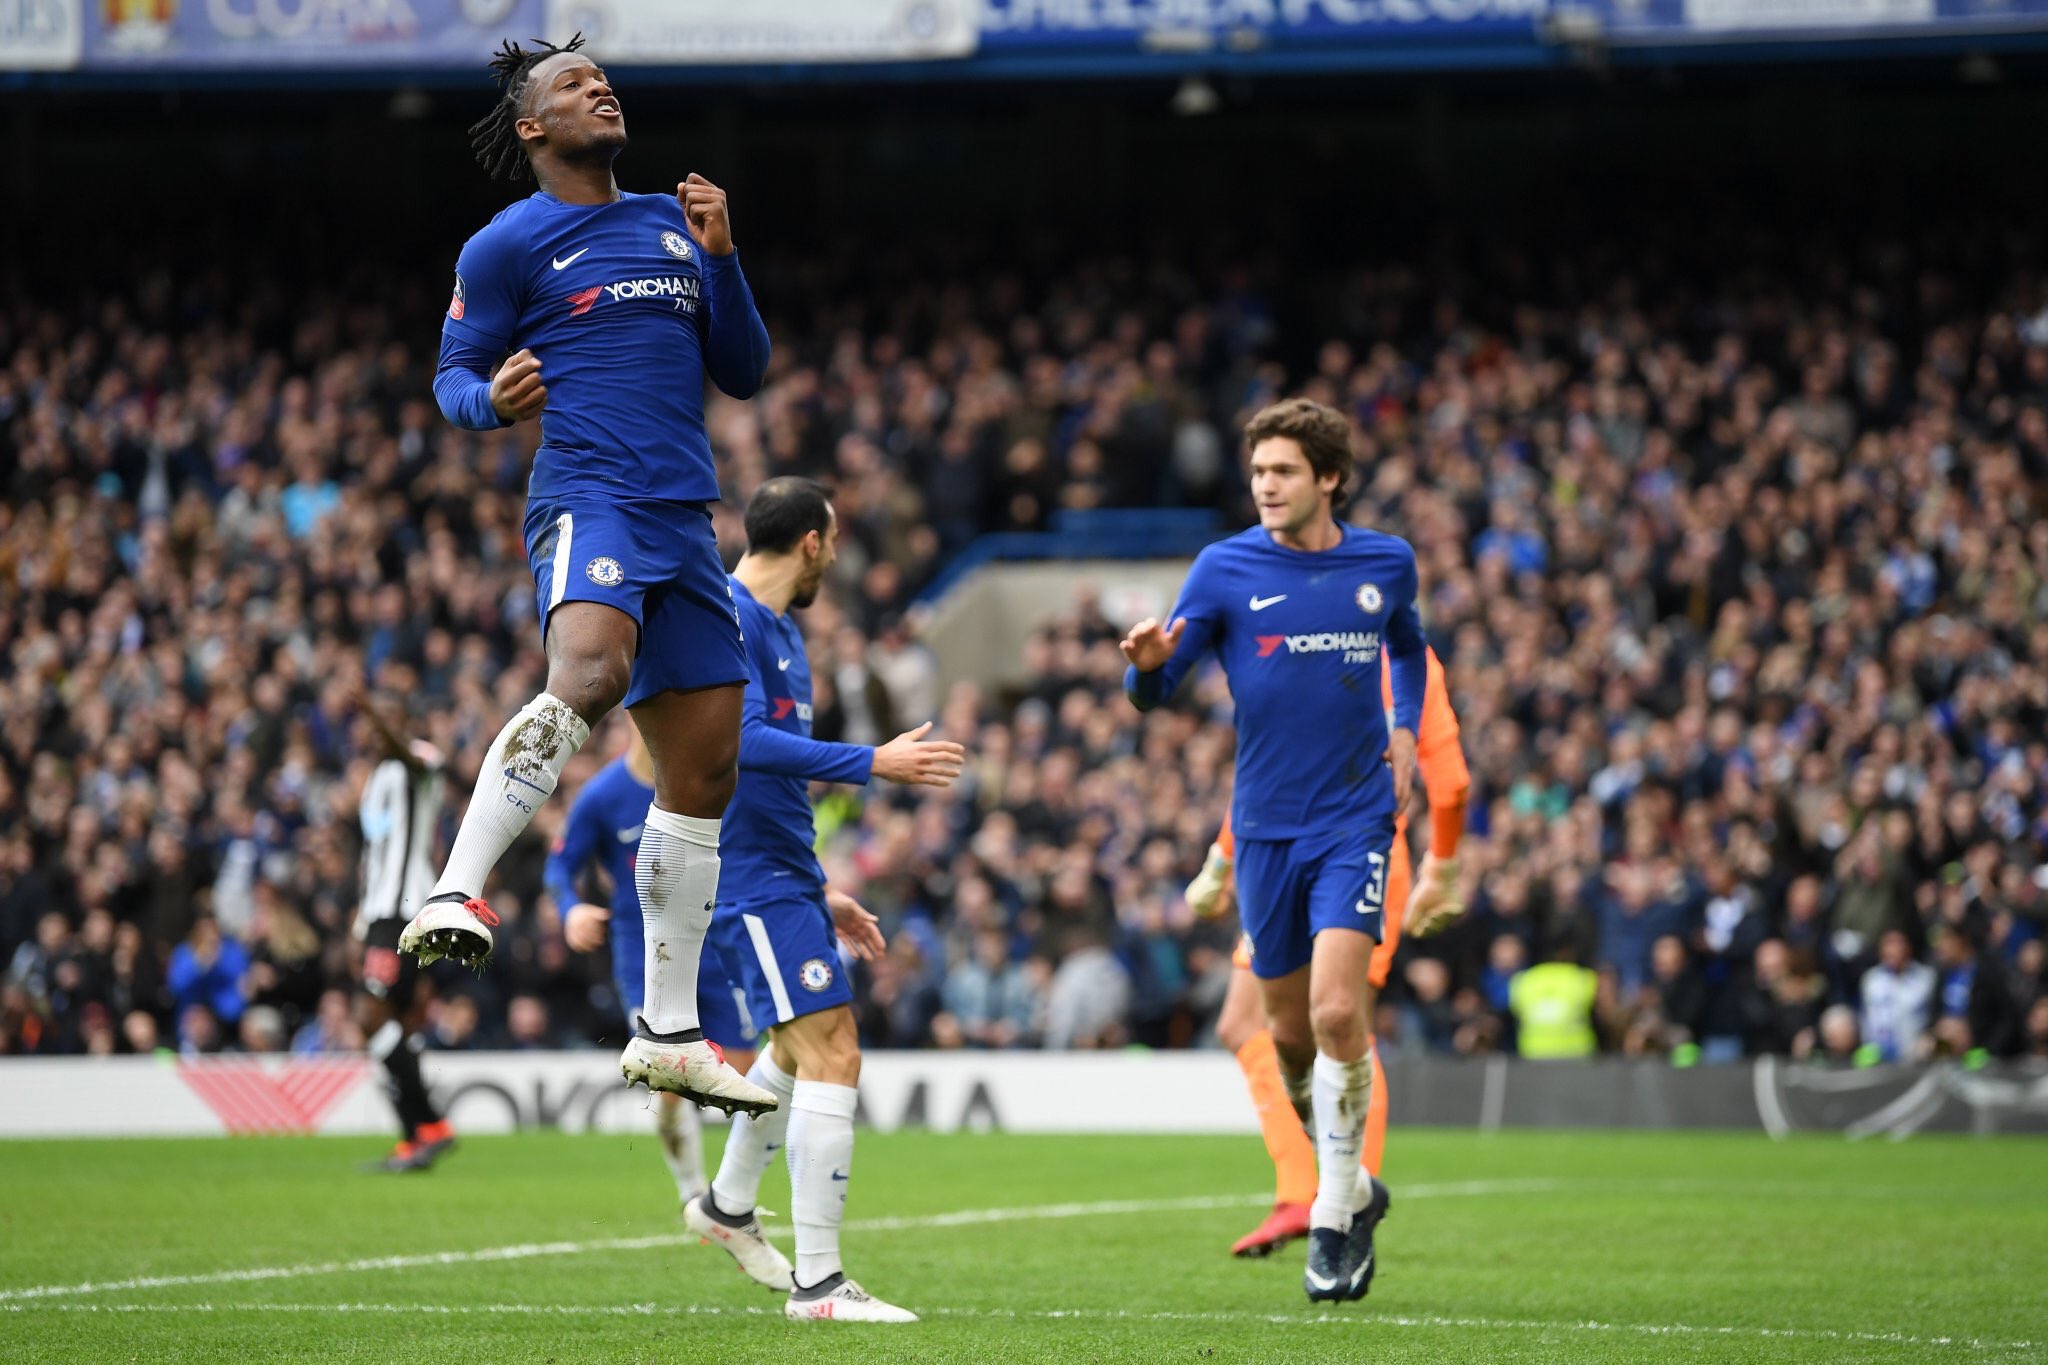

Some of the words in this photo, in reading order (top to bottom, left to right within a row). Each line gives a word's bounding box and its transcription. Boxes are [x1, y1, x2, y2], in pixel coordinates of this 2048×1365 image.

[674, 297, 698, 313] TYRE
[506, 793, 532, 814] CFC
[1365, 852, 1385, 905] 3
